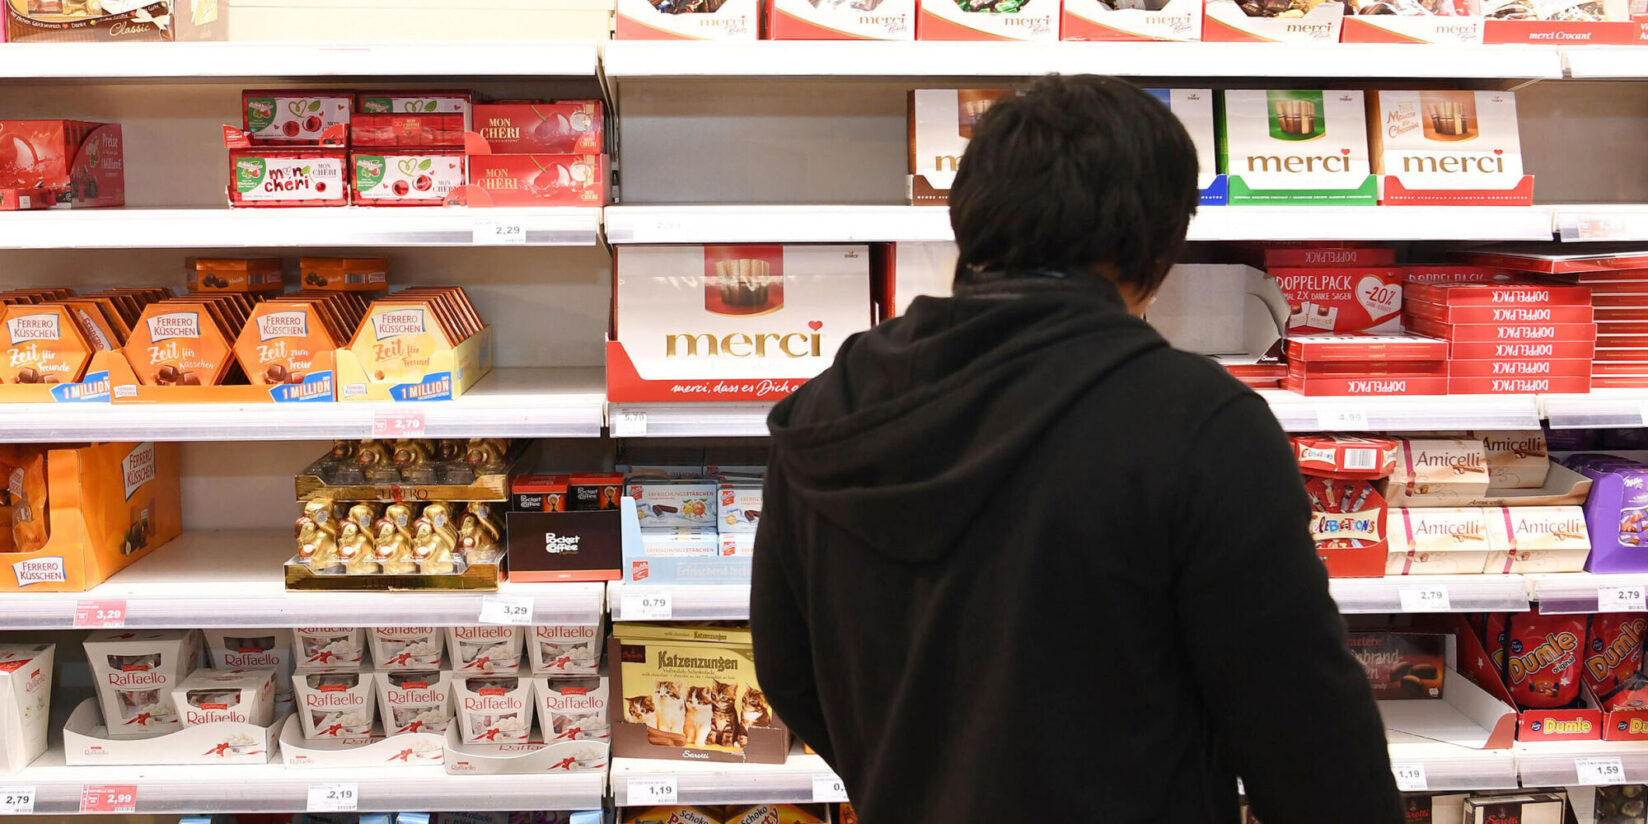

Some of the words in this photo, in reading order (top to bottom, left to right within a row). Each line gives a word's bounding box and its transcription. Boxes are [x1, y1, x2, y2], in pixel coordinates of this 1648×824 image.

[859, 13, 907, 25] merci
[1004, 15, 1051, 27] merci
[1145, 13, 1191, 26] merci
[109, 22, 151, 37] Classic
[1286, 22, 1333, 35] merci
[1436, 23, 1478, 35] merci
[1528, 32, 1554, 40] merci
[489, 118, 511, 127] MON
[1246, 148, 1351, 173] merci
[1403, 149, 1504, 174] merci
[486, 168, 509, 177] MON
[496, 226, 521, 235] 2,29
[1277, 275, 1352, 291] DOPPELPACK
[1296, 291, 1309, 300] 2X
[1365, 287, 1395, 307] -20%
[1491, 290, 1549, 302] DOPPELPACK
[266, 315, 301, 326] FERRERO
[382, 313, 418, 324] FERRERO
[1493, 308, 1551, 321] DOPPELPACK
[17, 319, 54, 329] FERRERO
[156, 317, 193, 327] FERRERO
[14, 328, 56, 338] KÜSSCHEN
[154, 326, 196, 337] KÜSSCHEN
[263, 325, 304, 336] KÜSSCHEN
[379, 324, 422, 334] KÜSSCHEN
[1496, 326, 1555, 339] DOPPELPACK
[665, 321, 824, 359] merci
[7, 344, 40, 367] Zeit
[146, 341, 180, 365] Zeit
[256, 341, 289, 364] Zeit
[372, 338, 403, 363] Zeit
[1495, 344, 1553, 357] DOPPELPACK
[1492, 361, 1550, 374] DOPPELPACK
[71, 380, 110, 399] MILLION
[282, 387, 289, 401] 1
[290, 380, 331, 399] MILLION
[401, 387, 408, 400] 1
[409, 378, 451, 399] MILLION
[671, 381, 711, 395] merci,
[713, 380, 740, 393] dass
[742, 384, 755, 393] es
[756, 379, 790, 396] Dich
[1347, 380, 1406, 393] DOPPELPACK
[1491, 379, 1549, 392] DOPPELPACK
[1482, 436, 1541, 452] Amicelli
[129, 447, 154, 470] FERRERO
[1414, 451, 1481, 468] Amicelli
[1415, 519, 1480, 535] Amicelli
[1515, 518, 1580, 535] Amicelli
[545, 532, 581, 544] Pocket
[545, 543, 579, 554] Coffee
[22, 561, 59, 572] FERRERO
[19, 570, 62, 581] KÜSSCHEN
[1421, 590, 1443, 600] 2,79
[1618, 590, 1641, 600] 2,79
[642, 599, 667, 607] 0,79
[96, 610, 121, 620] 3,29
[504, 605, 528, 615] 3,29
[455, 626, 513, 639] Raffaello
[536, 626, 595, 639] Raffaello
[1584, 618, 1647, 683] Dumle
[225, 654, 280, 667] Raffaello
[657, 650, 739, 672] Katzenzungen
[1508, 631, 1578, 684] Dumle
[108, 672, 167, 687] Raffaello
[306, 692, 364, 707] Raffaello
[388, 690, 445, 704] Raffaello
[464, 696, 523, 711] Raffaello
[546, 696, 604, 711] Raffaello
[186, 710, 247, 726] Raffaello
[1544, 717, 1593, 734] Dumle
[1399, 769, 1420, 778] 1,19
[1597, 765, 1618, 775] 1,59
[649, 785, 672, 795] 1,19
[5, 794, 30, 806] 2,79
[107, 793, 133, 804] 2,99
[679, 809, 710, 824] Schoko
